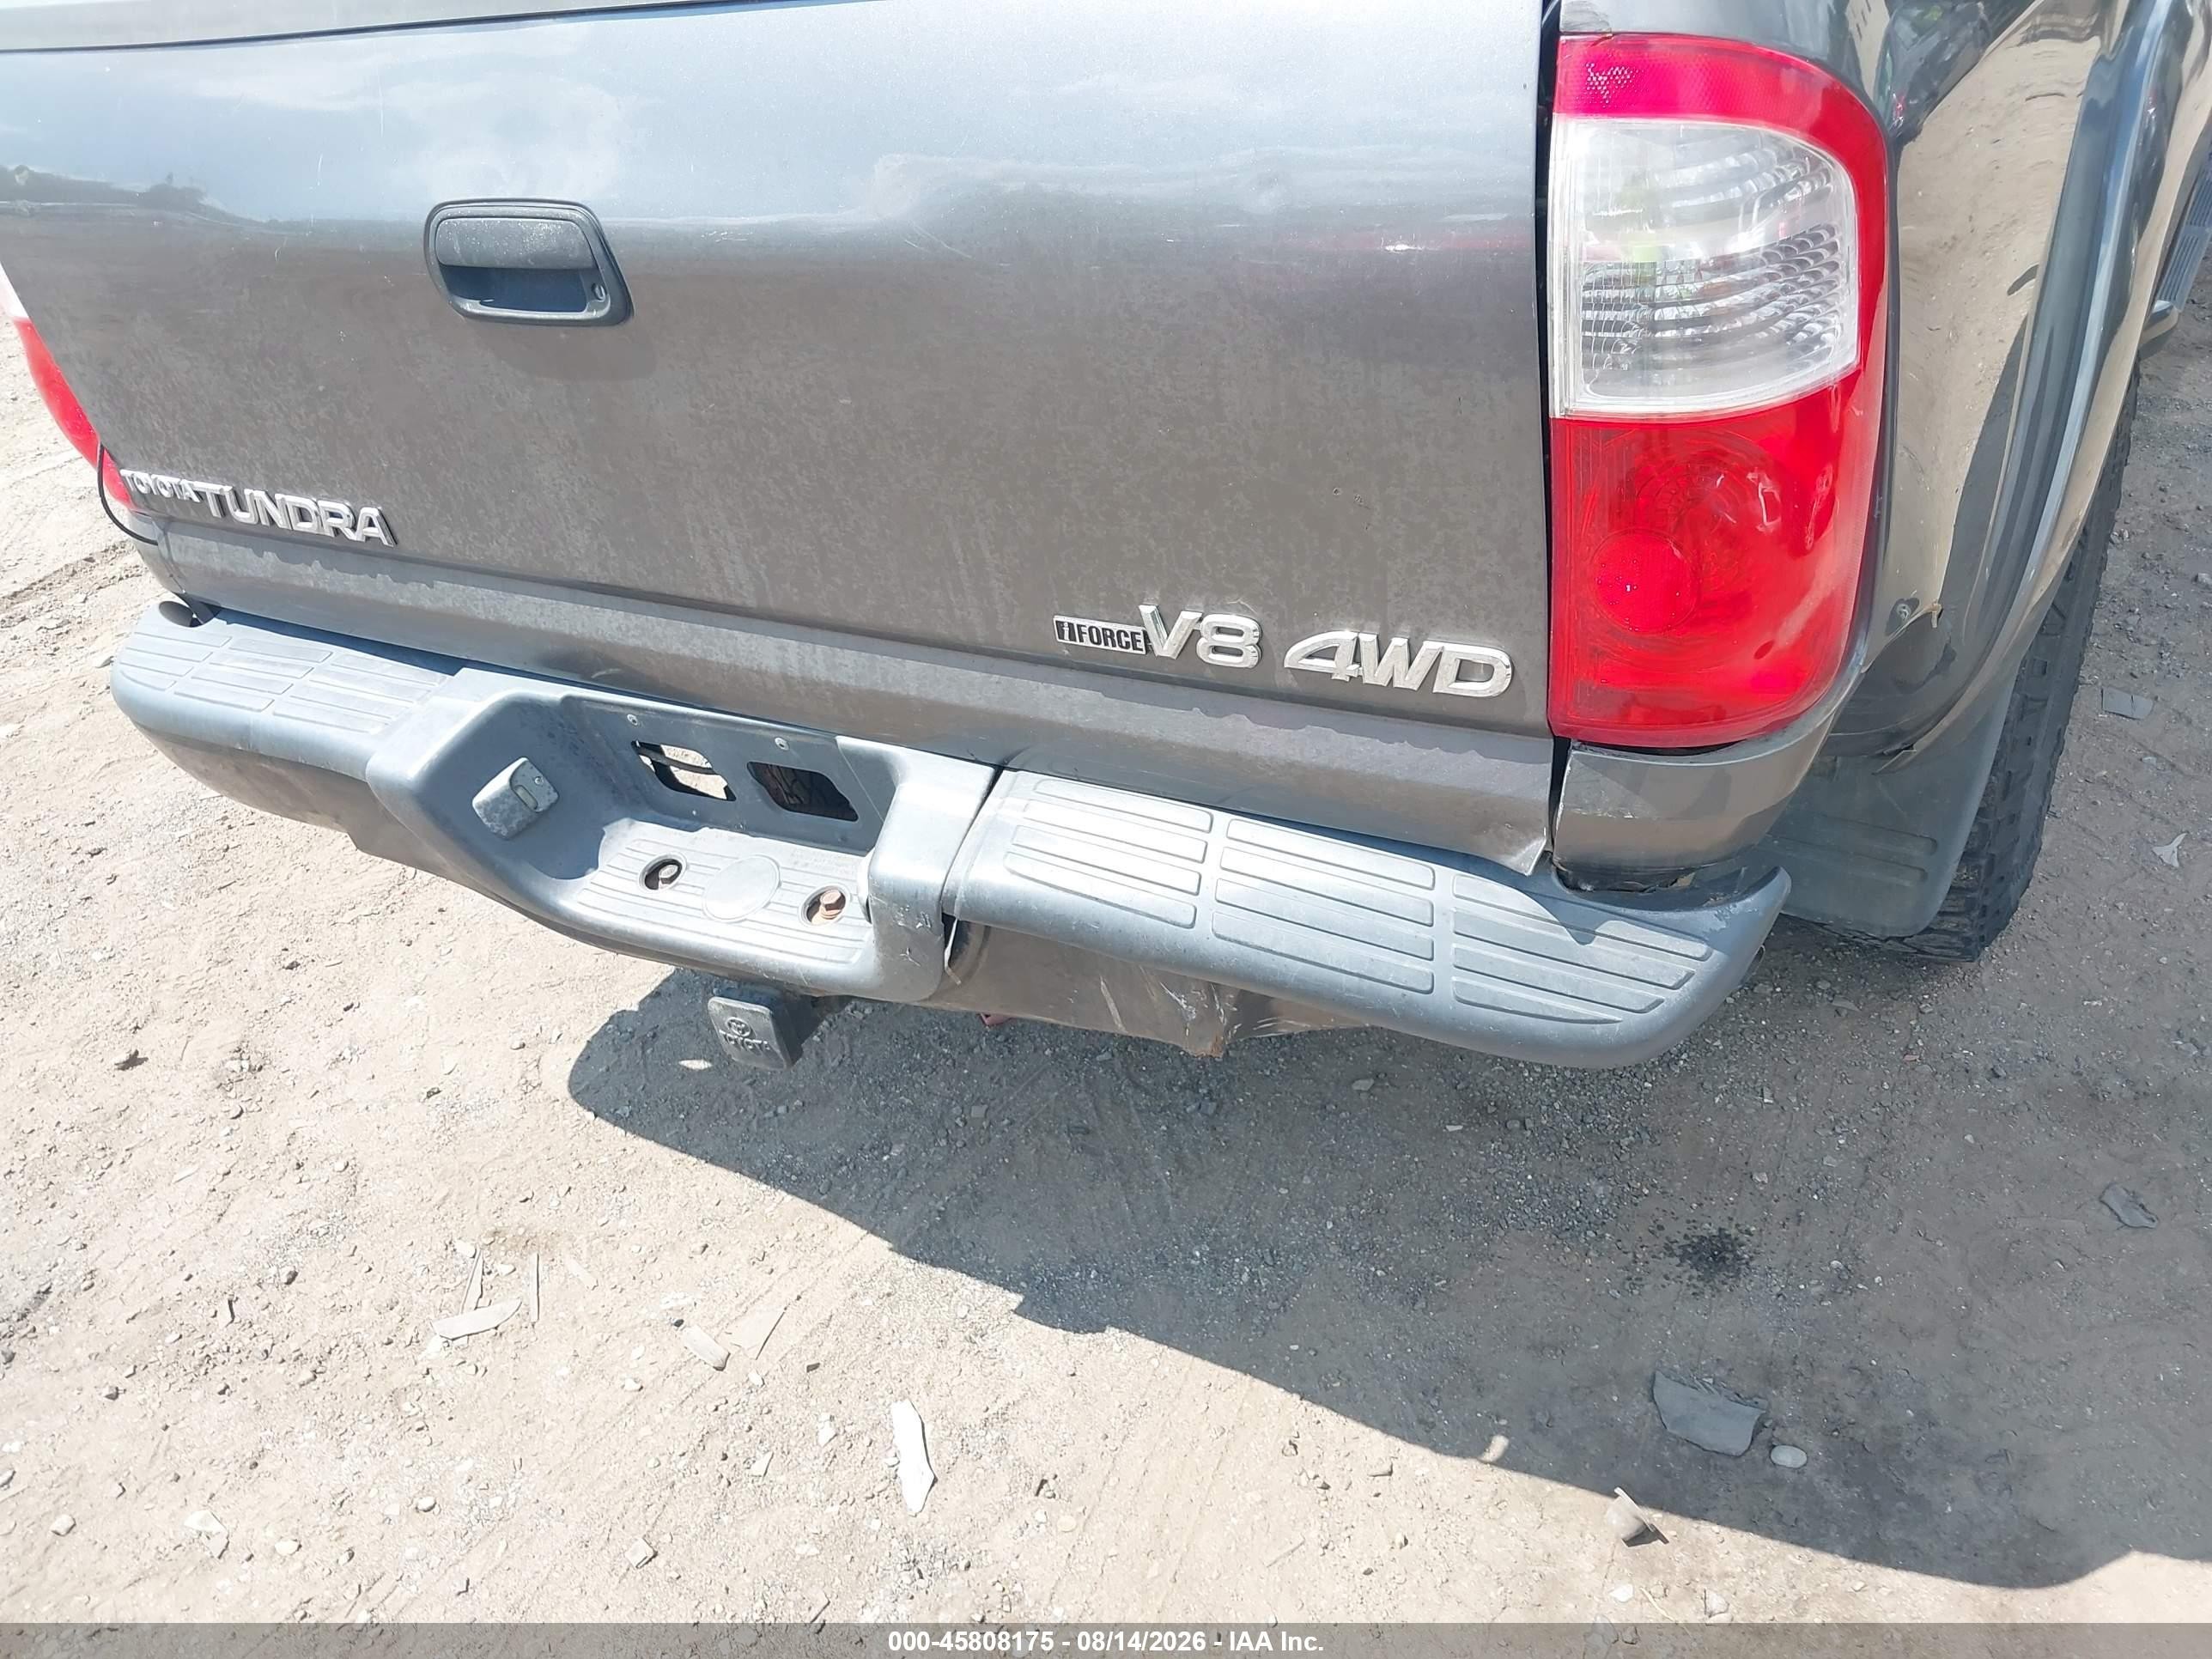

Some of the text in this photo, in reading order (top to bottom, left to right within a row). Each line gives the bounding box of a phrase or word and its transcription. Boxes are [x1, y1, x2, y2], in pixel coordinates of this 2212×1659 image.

[120, 469, 398, 547] TOYOTA TUNDRA
[1139, 604, 1261, 669] V8
[1284, 630, 1513, 697] 4WD
